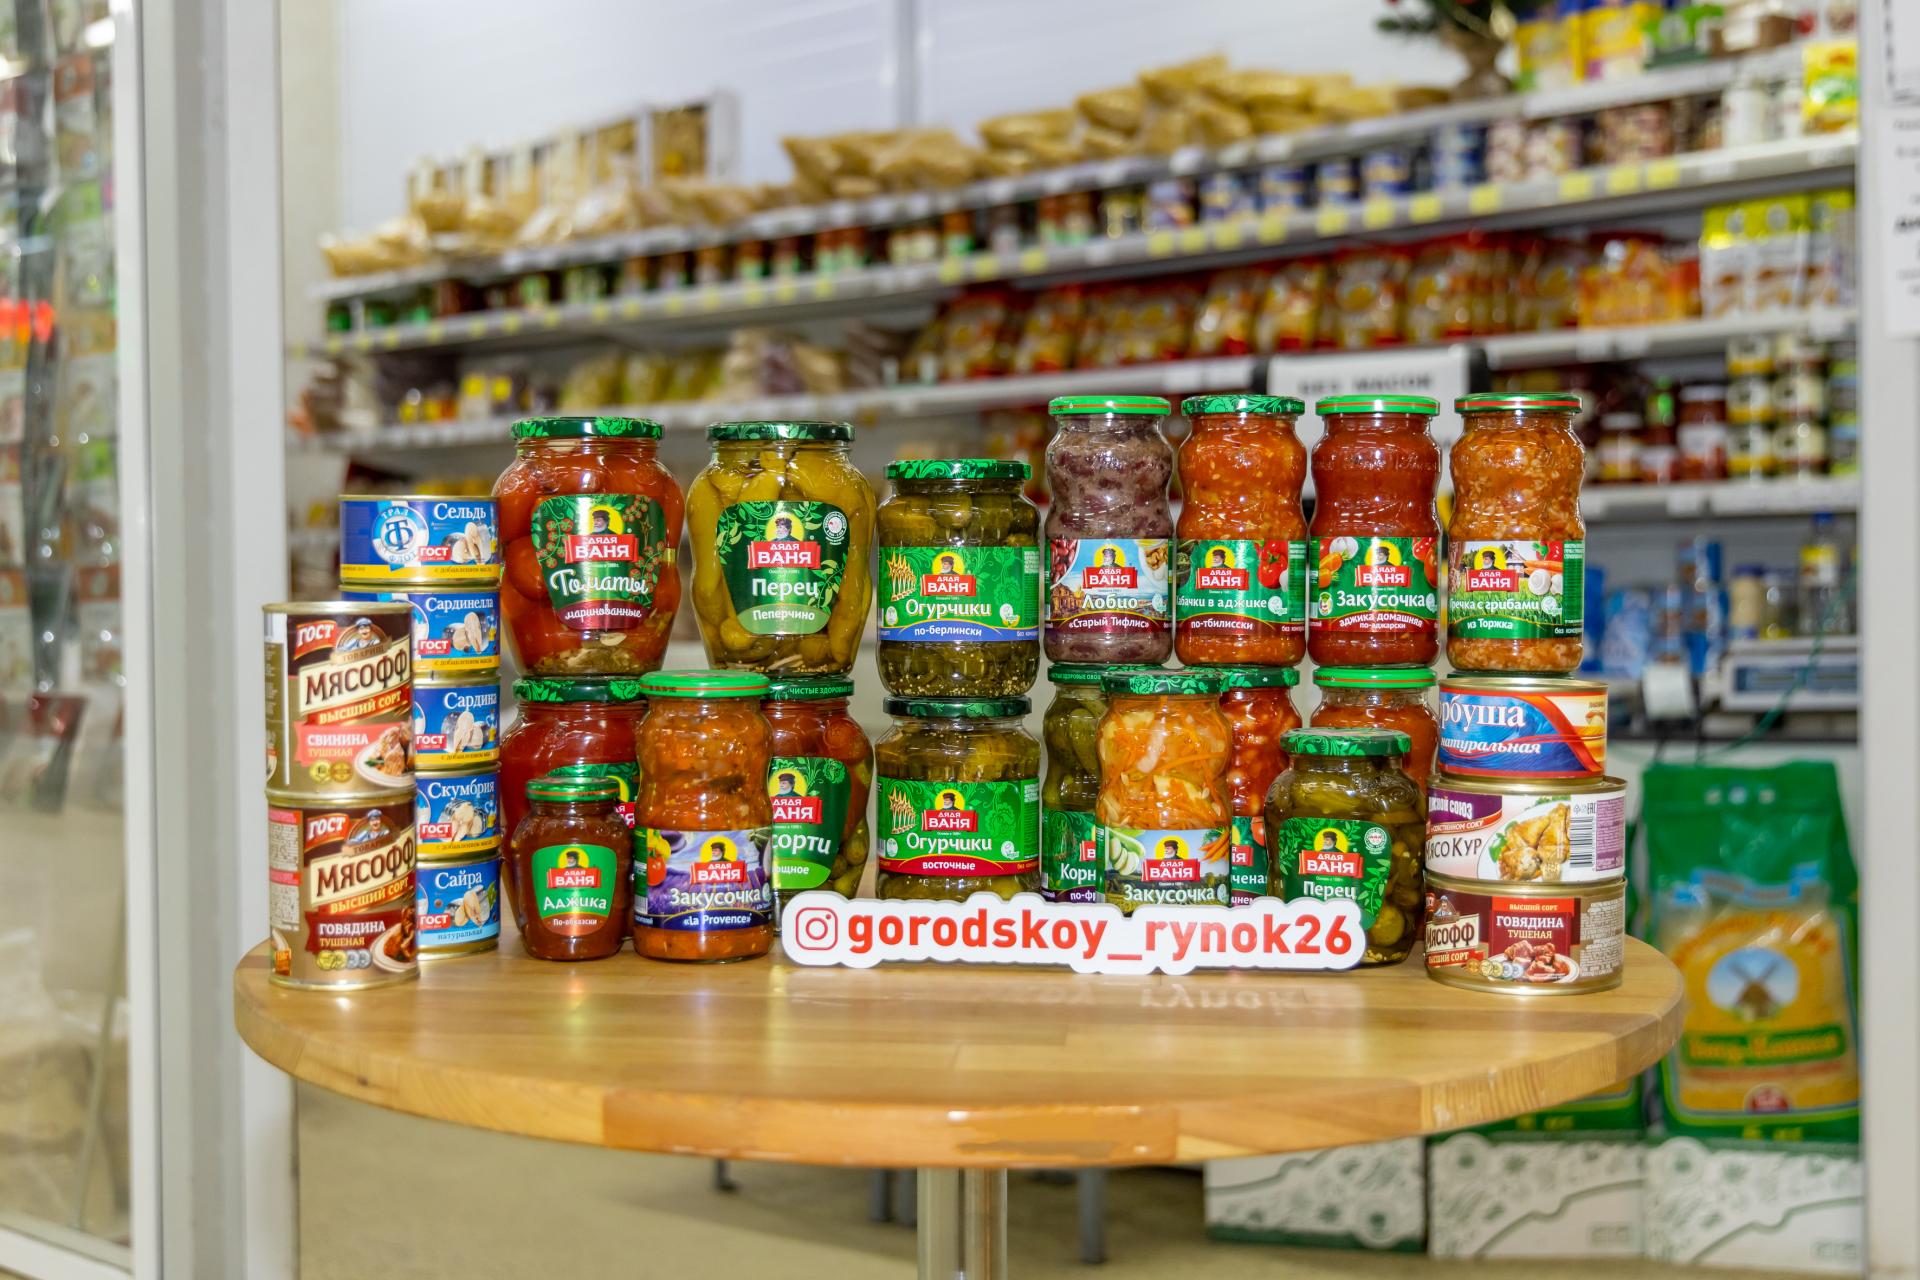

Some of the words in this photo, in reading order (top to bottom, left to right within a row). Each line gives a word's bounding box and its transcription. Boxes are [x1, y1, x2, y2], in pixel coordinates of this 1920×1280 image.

[433, 503, 486, 520] Сельдь
[420, 546, 448, 557] ГОСТ
[575, 545, 630, 558] ВАНЯ
[770, 543, 800, 551] ДЯДЯ
[757, 551, 812, 564] ВАНЯ
[549, 569, 649, 596] Томаты
[1089, 575, 1130, 585] ВАНЯ
[1201, 576, 1241, 586] ВАНЯ
[1363, 573, 1405, 583] ВАНЯ
[1470, 577, 1511, 589] ВАНЯ
[752, 578, 820, 601] Перец
[927, 583, 969, 593] ВАНЯ
[425, 597, 494, 613] Сардинелла
[1081, 594, 1138, 609] Лобио
[1208, 599, 1214, 607] в
[1217, 598, 1267, 609] аджике
[1336, 590, 1425, 610] Закусочка
[1477, 601, 1483, 609] с
[1485, 598, 1539, 613] грибами
[565, 604, 642, 622] маринованные
[752, 609, 816, 621] Пеперчино
[905, 599, 991, 619] Огурчики
[1068, 617, 1108, 629] «Старый
[1110, 616, 1149, 629] Тифлис»
[1190, 618, 1253, 630] по-тбилисски
[1339, 612, 1375, 628] аджика
[1376, 612, 1423, 628] домашняя
[1359, 622, 1406, 631] по-аджарски
[1467, 621, 1477, 630] из
[1478, 618, 1514, 630] Торжка
[296, 622, 335, 646] ГОСТ
[914, 624, 982, 637] по-берлински
[420, 640, 448, 651] ГОСТ
[789, 687, 818, 695] ЧИСТЫЕ
[318, 698, 376, 725] ВЫСШИЙ
[377, 690, 402, 709] СОРТ
[444, 692, 497, 710] Сардина
[1439, 694, 1526, 732] рбуша
[307, 732, 369, 747] СВИНИНА
[416, 735, 444, 745] ГОСТ
[307, 747, 353, 758] ТУШЕНАЯ
[427, 778, 495, 801] Скумбрия
[307, 816, 346, 840] ГОСТ
[421, 825, 450, 834] ГОСТ
[928, 818, 970, 828] ВАНЯ
[906, 832, 993, 855] Огурчики
[1317, 853, 1344, 861] ДЯДЯ
[922, 861, 976, 871] восточные
[1149, 867, 1193, 878] ВАНЯ
[1307, 860, 1355, 874] ВАНЯ
[435, 872, 482, 891] Сайра
[555, 876, 595, 886] ВАНЯ
[697, 869, 741, 881] ВАНЯ
[330, 885, 386, 913] ВЫСШИЙ
[387, 876, 409, 895] СОРТ
[1124, 884, 1215, 904] Закусочка
[1303, 881, 1356, 900] Перец
[543, 896, 607, 911] Аджика
[669, 887, 761, 909] Закусочка
[1509, 903, 1541, 911] ВЫСШИЙ
[419, 915, 448, 925] ГОСТ
[1496, 915, 1564, 929] ГОВЯДИНА
[319, 921, 386, 936] ГОВЯДИНА
[437, 929, 482, 940] натуральная
[848, 908, 1352, 961] gorodskoy_rynok26
[1507, 929, 1553, 939] ТУШЕНАЯ
[319, 937, 365, 948] ТУШЕНАЯ
[1450, 951, 1470, 962] СОРТ
